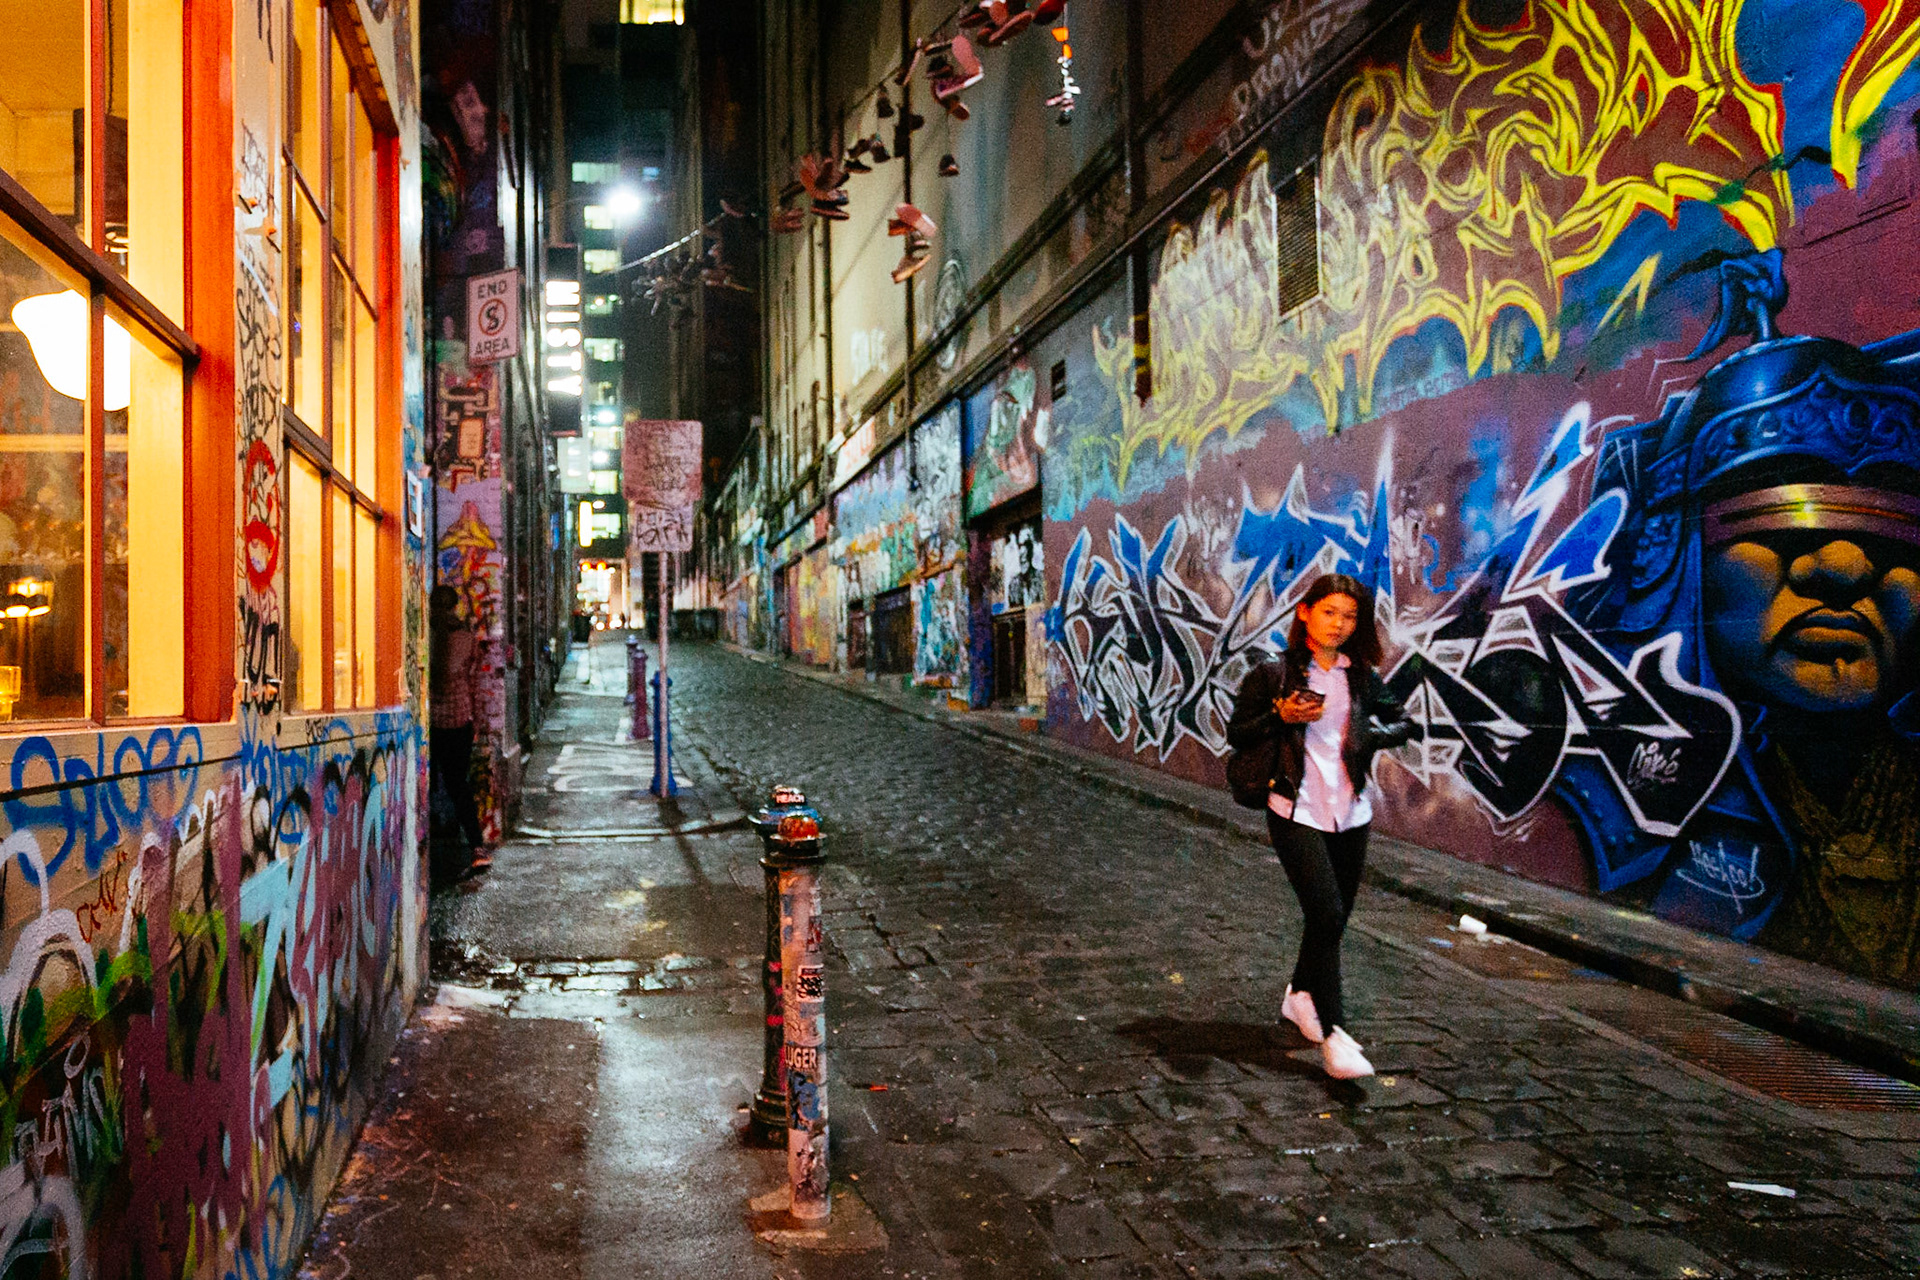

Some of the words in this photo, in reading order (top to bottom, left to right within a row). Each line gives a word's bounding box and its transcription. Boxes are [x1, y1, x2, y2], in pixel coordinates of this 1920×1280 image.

[477, 280, 508, 300] END
[474, 337, 510, 356] AREA
[544, 279, 582, 397] MISTY
